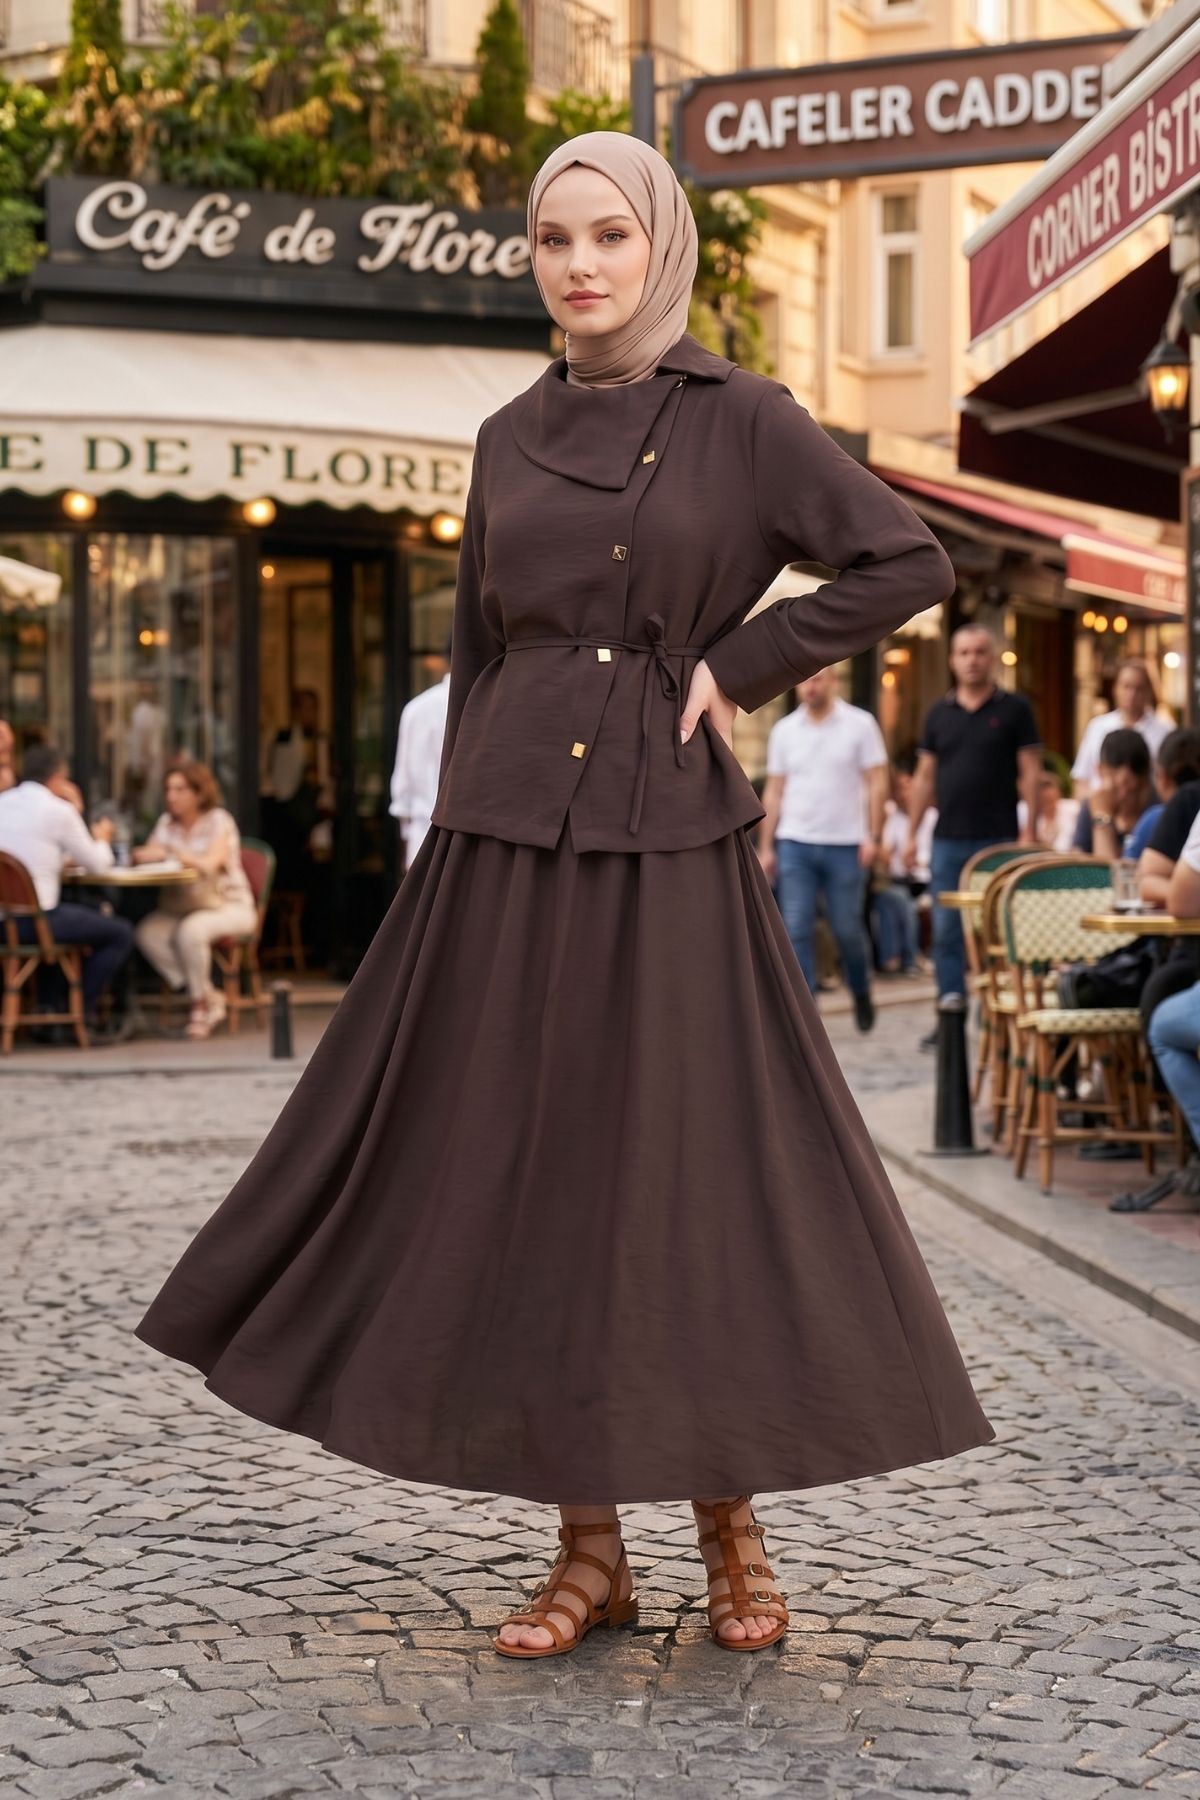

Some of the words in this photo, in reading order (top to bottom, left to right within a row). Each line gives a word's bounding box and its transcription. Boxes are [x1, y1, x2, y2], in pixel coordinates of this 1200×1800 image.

[704, 85, 914, 155] CAFELER
[75, 181, 251, 271] Café
[264, 208, 336, 266] de
[357, 201, 530, 279] Flore
[1026, 152, 1121, 290] CORNER
[84, 435, 191, 476] DE
[229, 441, 462, 497] FLORE
